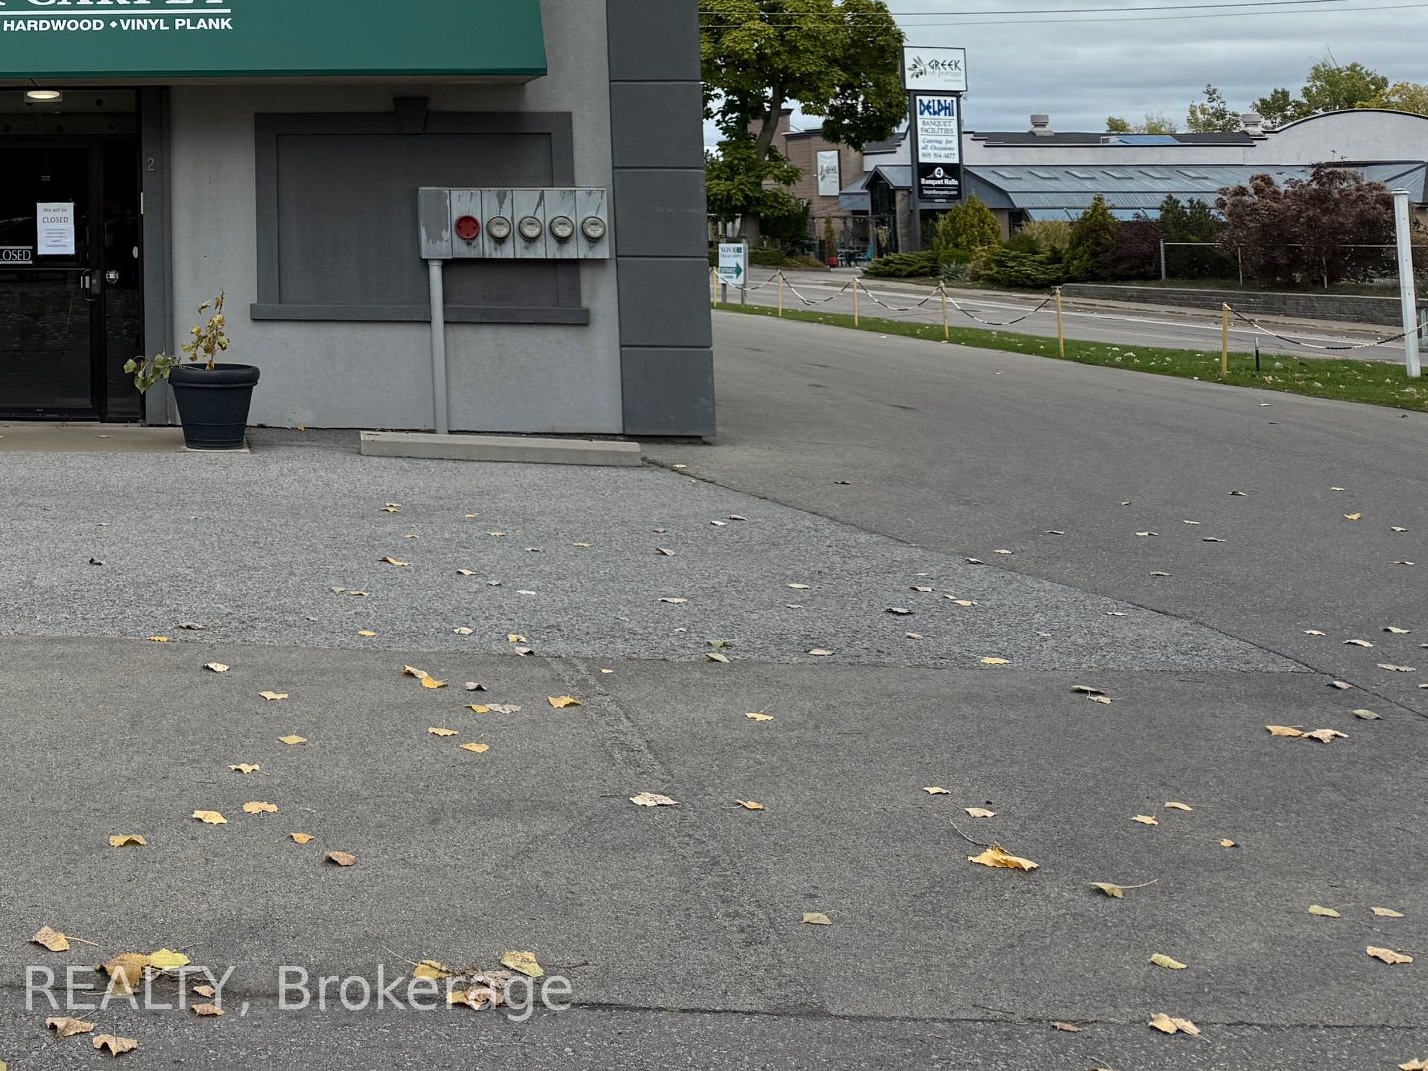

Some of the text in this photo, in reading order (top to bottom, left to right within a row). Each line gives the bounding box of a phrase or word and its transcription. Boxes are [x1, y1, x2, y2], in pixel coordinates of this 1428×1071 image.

[3, 19, 104, 32] HARDWOOD
[119, 18, 170, 31] VINYL
[174, 17, 233, 30] PLANK
[928, 59, 961, 71] GREEK
[147, 157, 155, 171] 2
[920, 178, 943, 186] Banquet
